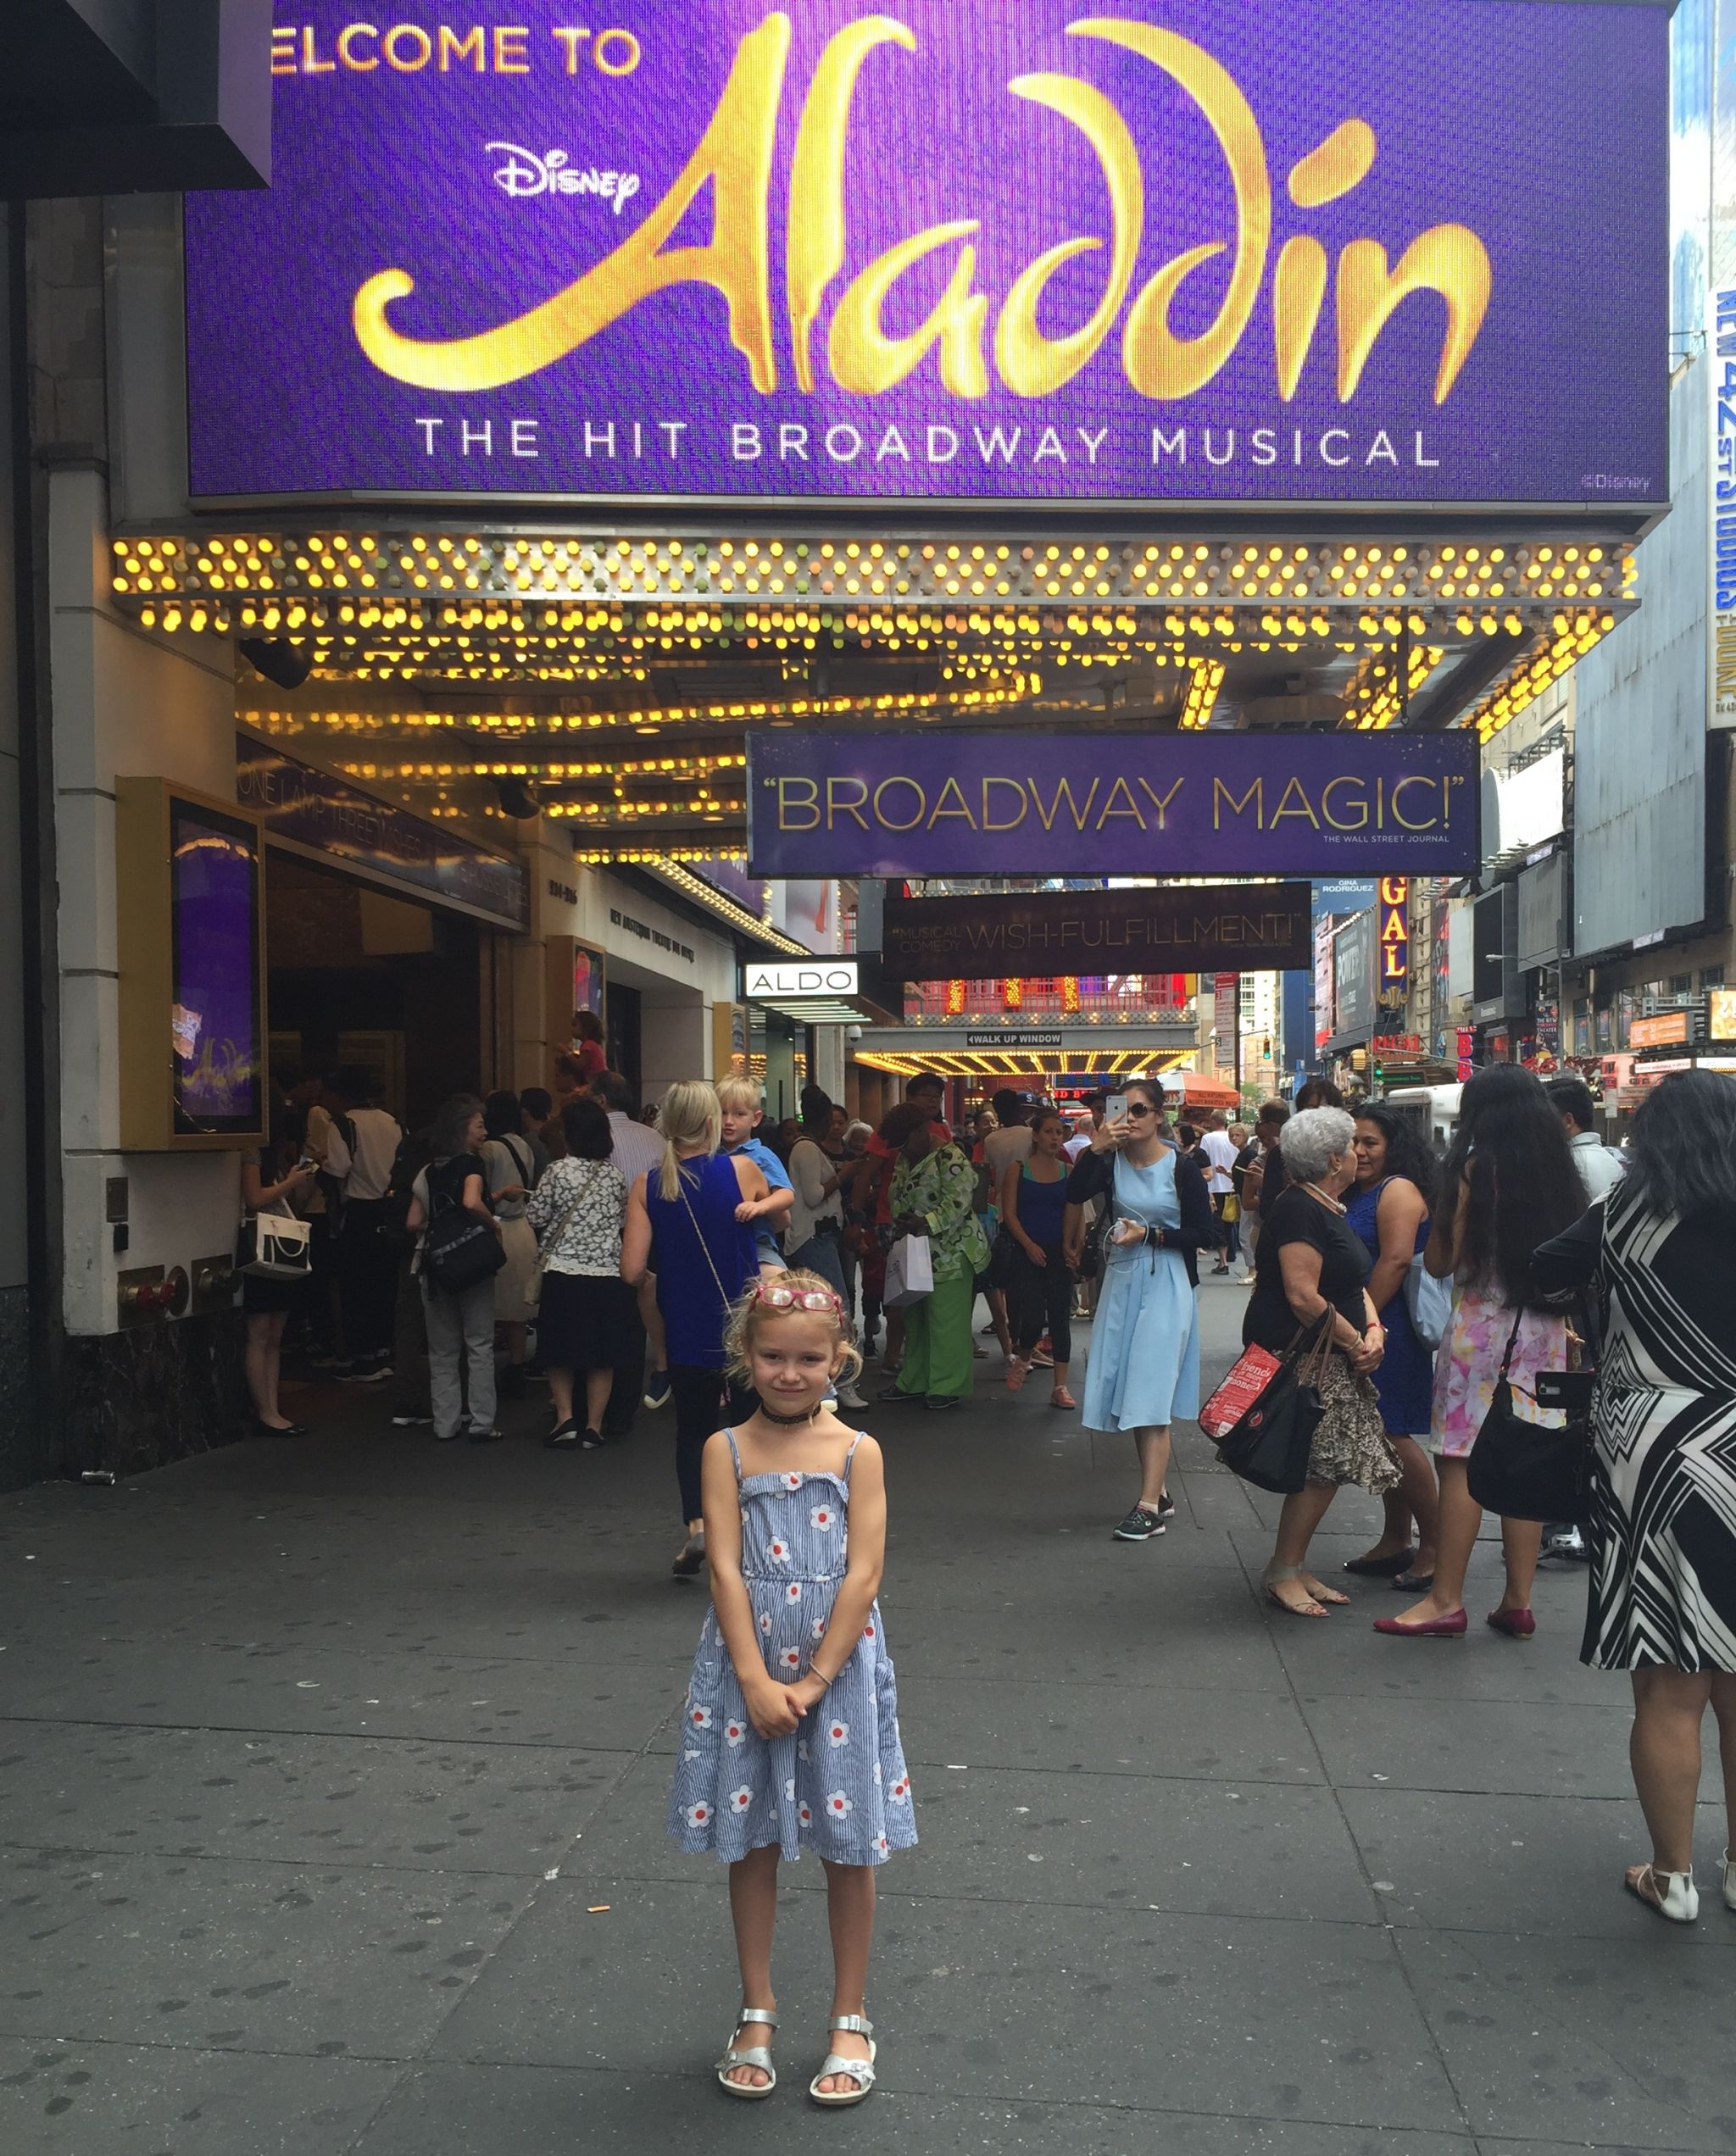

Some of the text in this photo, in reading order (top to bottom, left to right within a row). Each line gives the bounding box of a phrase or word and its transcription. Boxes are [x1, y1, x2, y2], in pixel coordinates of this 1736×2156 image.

[271, 22, 642, 77] ELCOME TO
[352, 11, 1493, 407] Aladdin
[415, 418, 1441, 468] THE HIT BROADWAY MUSICAL
[237, 761, 275, 806] ONE
[1323, 835, 1449, 843] THE WALL STREET JOURNAL
[899, 939, 963, 953] COMEDY
[1382, 876, 1408, 976] GAL
[752, 970, 853, 992] ALDO
[973, 1034, 1060, 1043] WALK UP WINDOW
